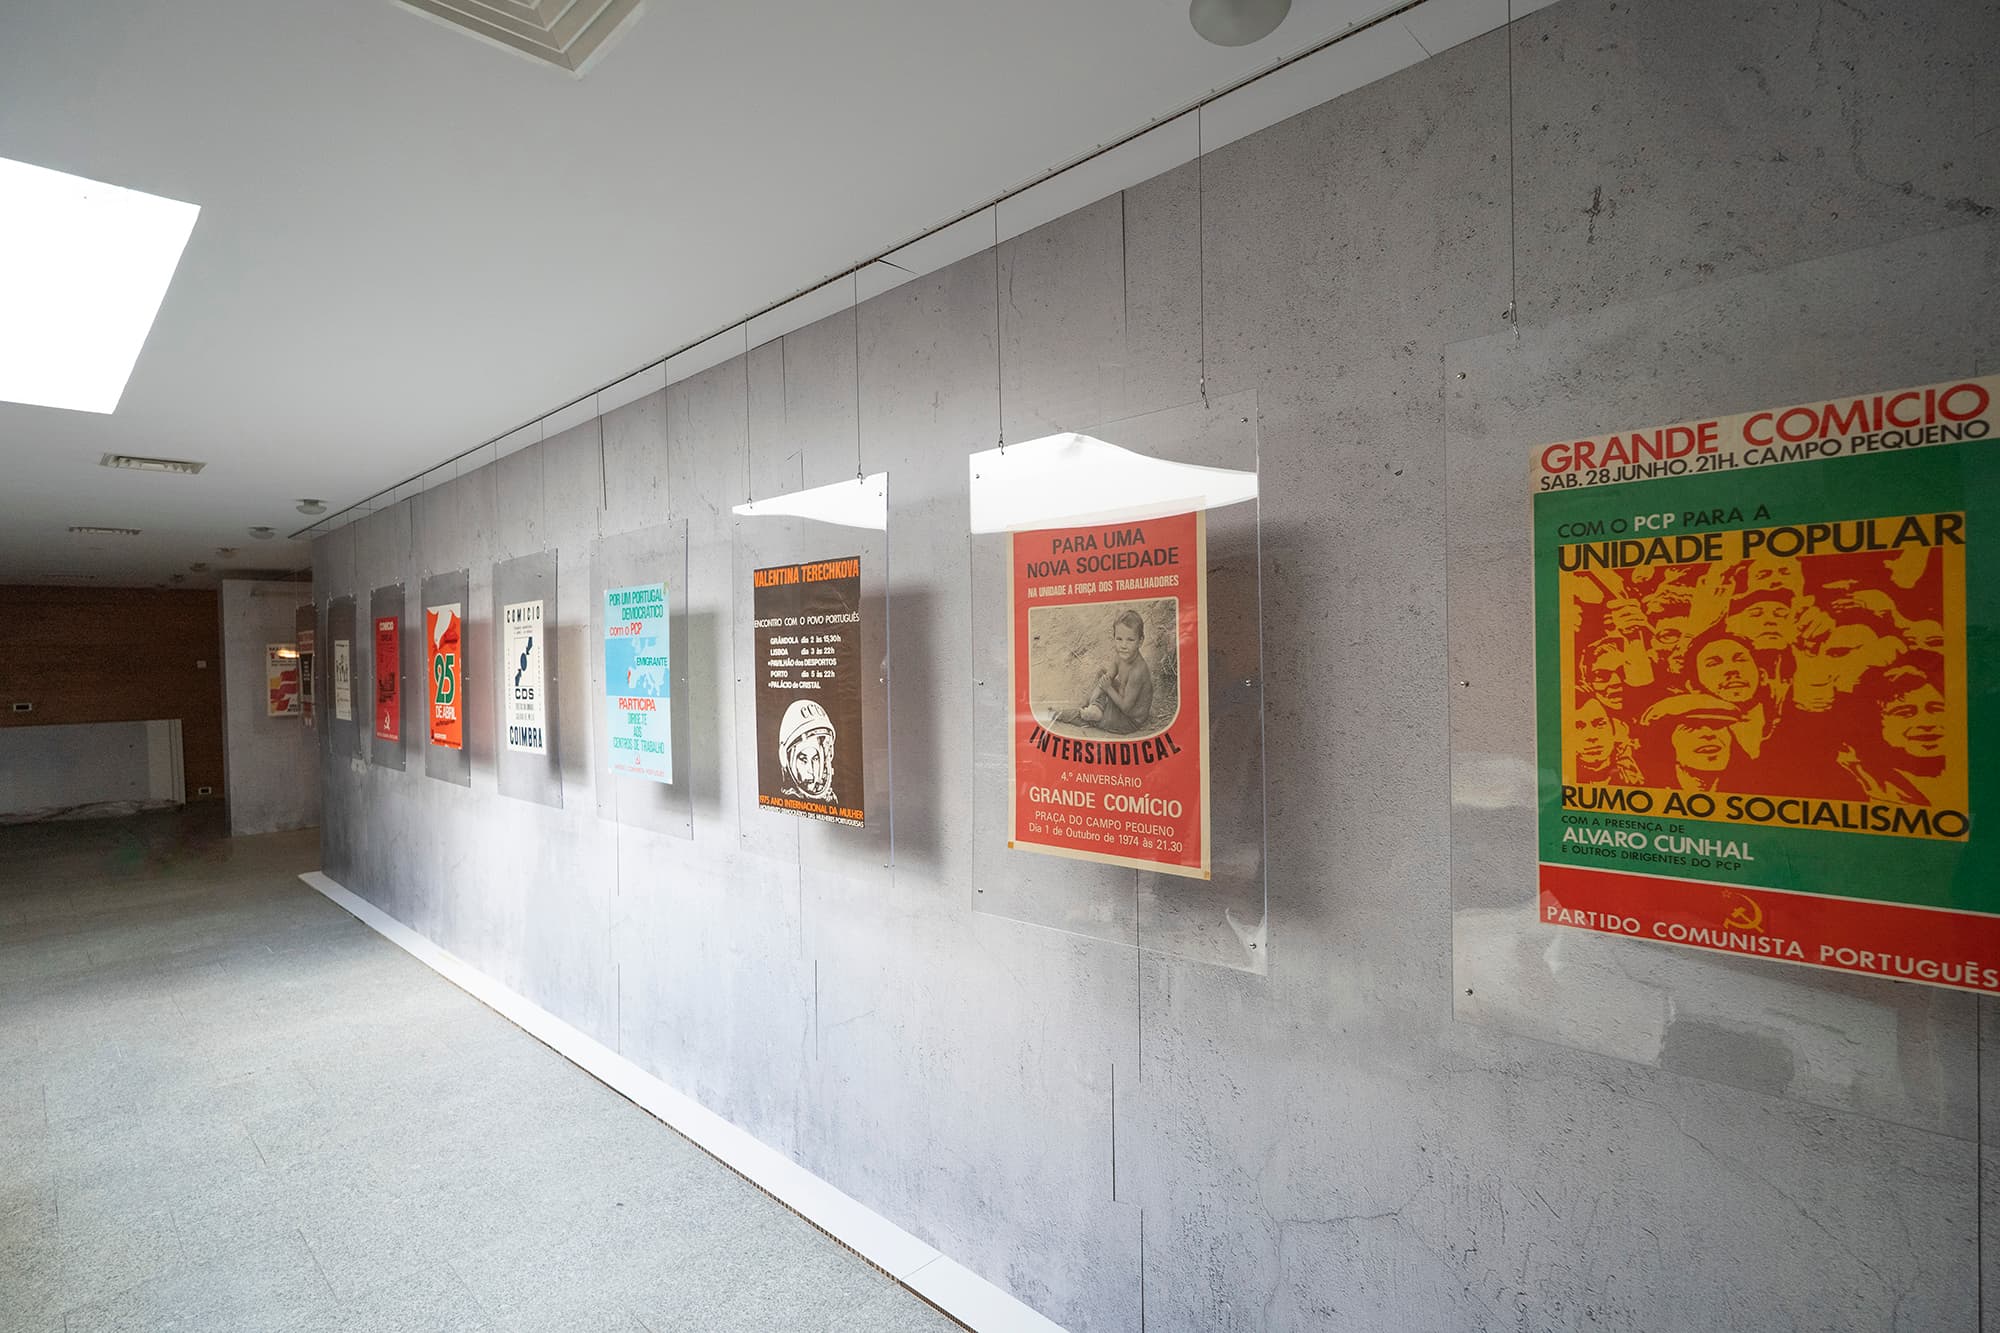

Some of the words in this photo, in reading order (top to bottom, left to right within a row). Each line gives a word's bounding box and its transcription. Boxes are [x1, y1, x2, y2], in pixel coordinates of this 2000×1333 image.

[1541, 421, 1718, 473] GRANDE
[1742, 382, 1990, 448] COMICIO
[1540, 470, 1583, 491] SAB.
[1743, 438, 1842, 466] CAMPO
[1850, 419, 1990, 454] PEQUENO
[1557, 521, 1605, 539] COM
[1610, 518, 1628, 534] O
[1634, 512, 1675, 532] PCP
[1683, 508, 1744, 528] PARA
[1753, 504, 1771, 521] A
[1053, 535, 1098, 554] PARA
[1104, 528, 1145, 549] UMA
[1558, 532, 1723, 572] UNIDADE
[1743, 512, 1966, 559] POPULAR
[1027, 559, 1071, 579] NOVA
[1076, 547, 1179, 574] SOCIEDADE
[754, 566, 800, 588] VALENTINA
[1028, 588, 1037, 598] NA
[1039, 585, 1066, 598] UNIDADE
[1068, 585, 1073, 595] A
[1074, 583, 1096, 596] FORÇA
[1099, 581, 1112, 593] DOS
[1116, 574, 1179, 592] TRABALHADORES
[609, 594, 620, 606] POR
[632, 589, 663, 604] PORTUGAL
[754, 618, 782, 628] ENCONTRO
[784, 617, 798, 626] COM
[800, 616, 806, 625] O
[807, 615, 823, 625] POVO
[825, 611, 860, 624] PORTUGUÊS
[810, 635, 815, 643] 2
[811, 647, 815, 655] 3
[434, 653, 456, 705] 25
[811, 670, 815, 678] 5
[515, 688, 534, 699] CDS
[618, 698, 656, 711] PARTICIPA
[509, 726, 543, 748] COIMBRA
[1029, 726, 1182, 766] INTERSINDICAL
[1075, 773, 1142, 788] ANIVERSÁRIO
[770, 797, 783, 807] ANO
[784, 799, 828, 814] INTERNACIONAL
[829, 806, 838, 816] DA
[839, 808, 864, 820] MULHER
[1029, 786, 1096, 809] GRANDE
[1103, 793, 1183, 819] COMÍCIO
[1562, 785, 1653, 814] RUMO
[1663, 792, 1716, 818] AO
[1726, 796, 1969, 838] SOCIALISMO
[1035, 810, 1066, 825] PRAÇA
[1069, 814, 1082, 826] DO
[1086, 816, 1122, 831] CAMPO
[1125, 821, 1175, 837] PEQUENO
[1562, 815, 1589, 826] COM
[1592, 818, 1600, 826] A
[1605, 818, 1663, 833] PRESENÇA
[1669, 824, 1685, 834] DE
[1029, 822, 1042, 833] Dia
[1045, 825, 1049, 834] 1
[1052, 825, 1063, 836] de
[1066, 827, 1101, 841] Outubro
[1103, 832, 1115, 844] de
[1118, 834, 1139, 846] 1974
[1142, 837, 1153, 849] às
[1156, 839, 1183, 853] 21.30
[1562, 827, 1648, 849] ALVARO
[1654, 835, 1754, 860] CUNHAL
[1562, 844, 1567, 853] E
[1572, 845, 1617, 858] OUTROS
[1622, 851, 1687, 865] DIRIGENTES
[1691, 858, 1711, 868] DO
[1716, 860, 1741, 871] PCP
[1546, 905, 1641, 934] PARTIDO
[1652, 921, 1805, 959] COMUNISTA
[1820, 943, 1999, 988] PORTUGUÊS
